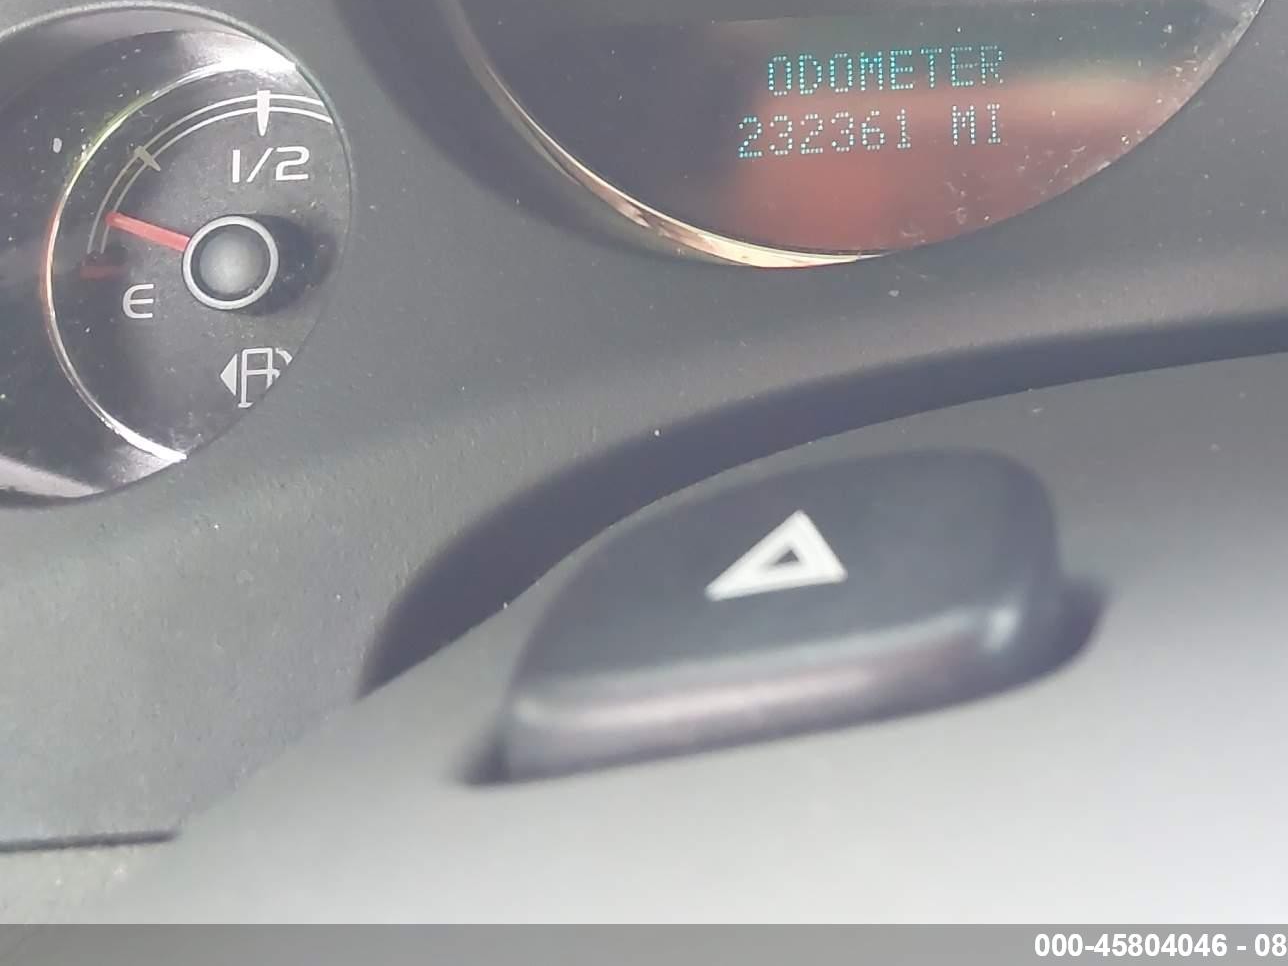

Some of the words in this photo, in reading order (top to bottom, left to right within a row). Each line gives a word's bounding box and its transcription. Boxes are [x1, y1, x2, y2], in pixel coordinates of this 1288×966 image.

[767, 44, 1004, 96] ODOMETER
[737, 108, 913, 159] 232361
[951, 102, 1002, 146] MI
[231, 145, 310, 184] 1/2
[122, 282, 155, 319] E
